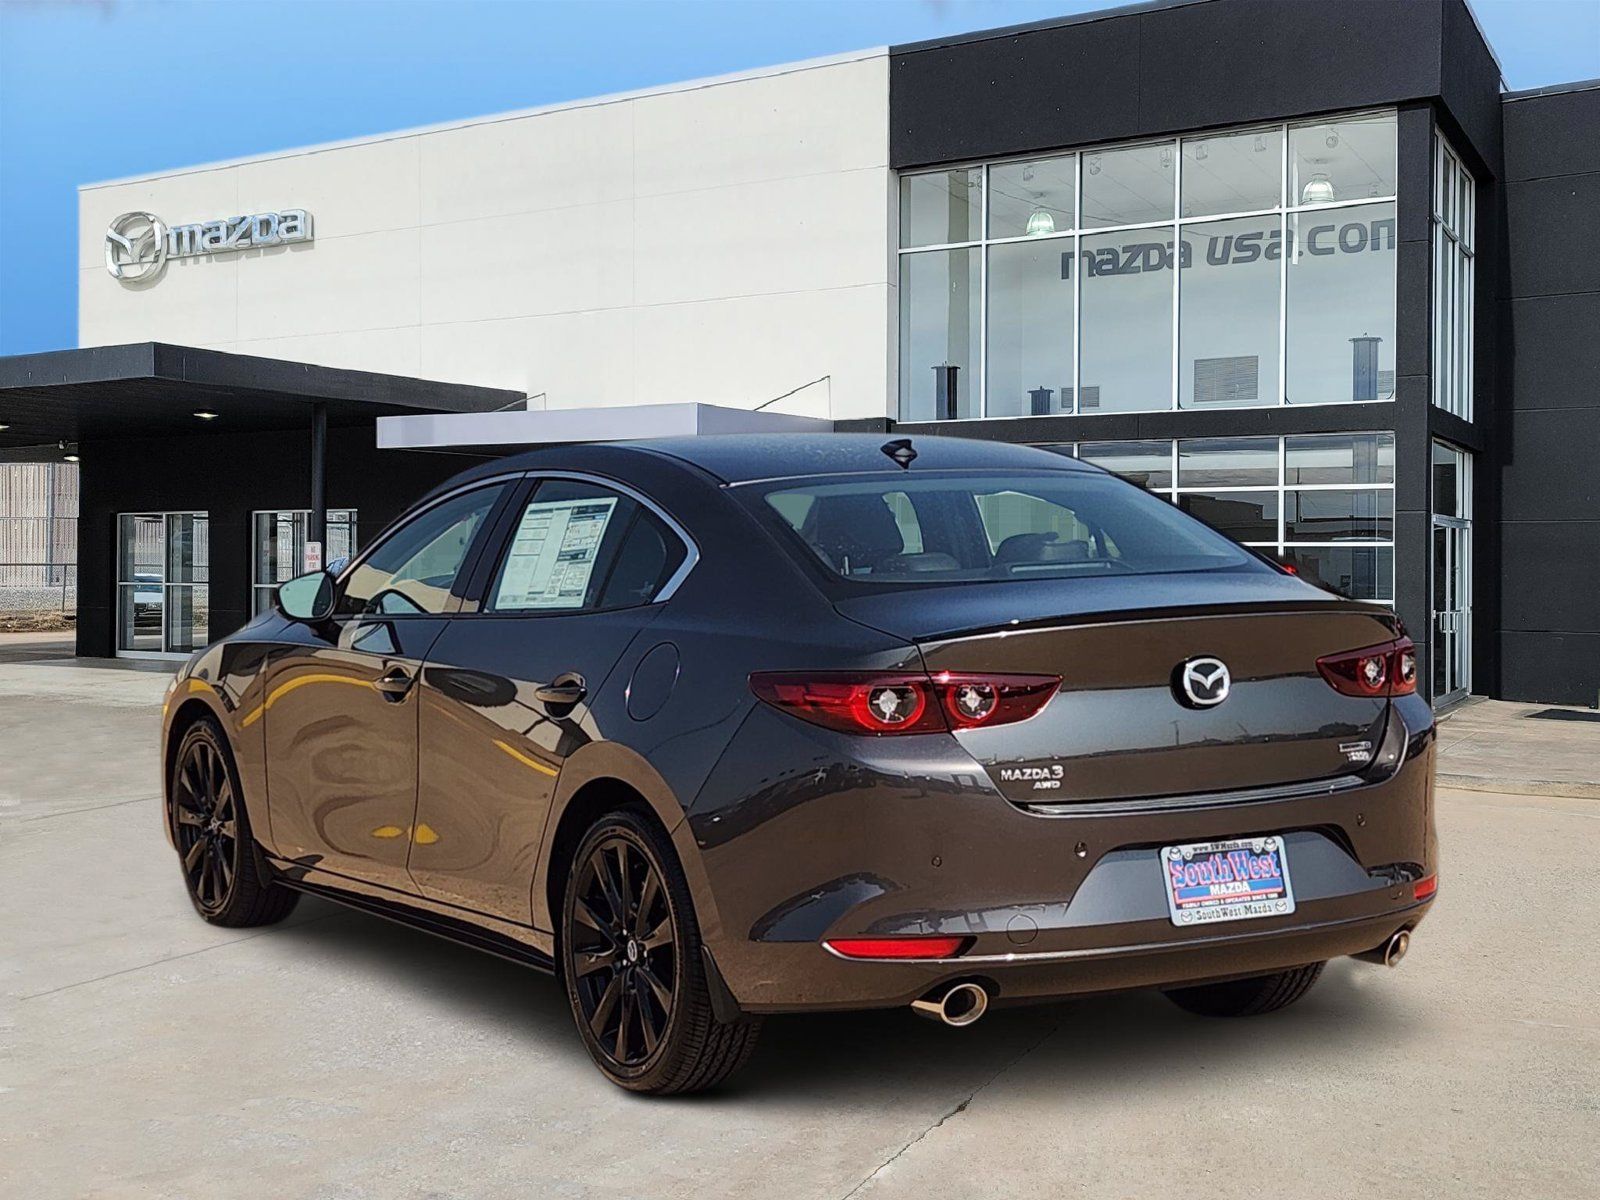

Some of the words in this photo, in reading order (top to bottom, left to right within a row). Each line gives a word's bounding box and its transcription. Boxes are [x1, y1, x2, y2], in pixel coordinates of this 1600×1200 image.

[1033, 781, 1061, 789] AWD
[1169, 850, 1281, 888] SouthWest
[1210, 881, 1251, 896] MAZDA
[1196, 905, 1242, 920] SouthWest
[1244, 903, 1272, 915] Mazda
